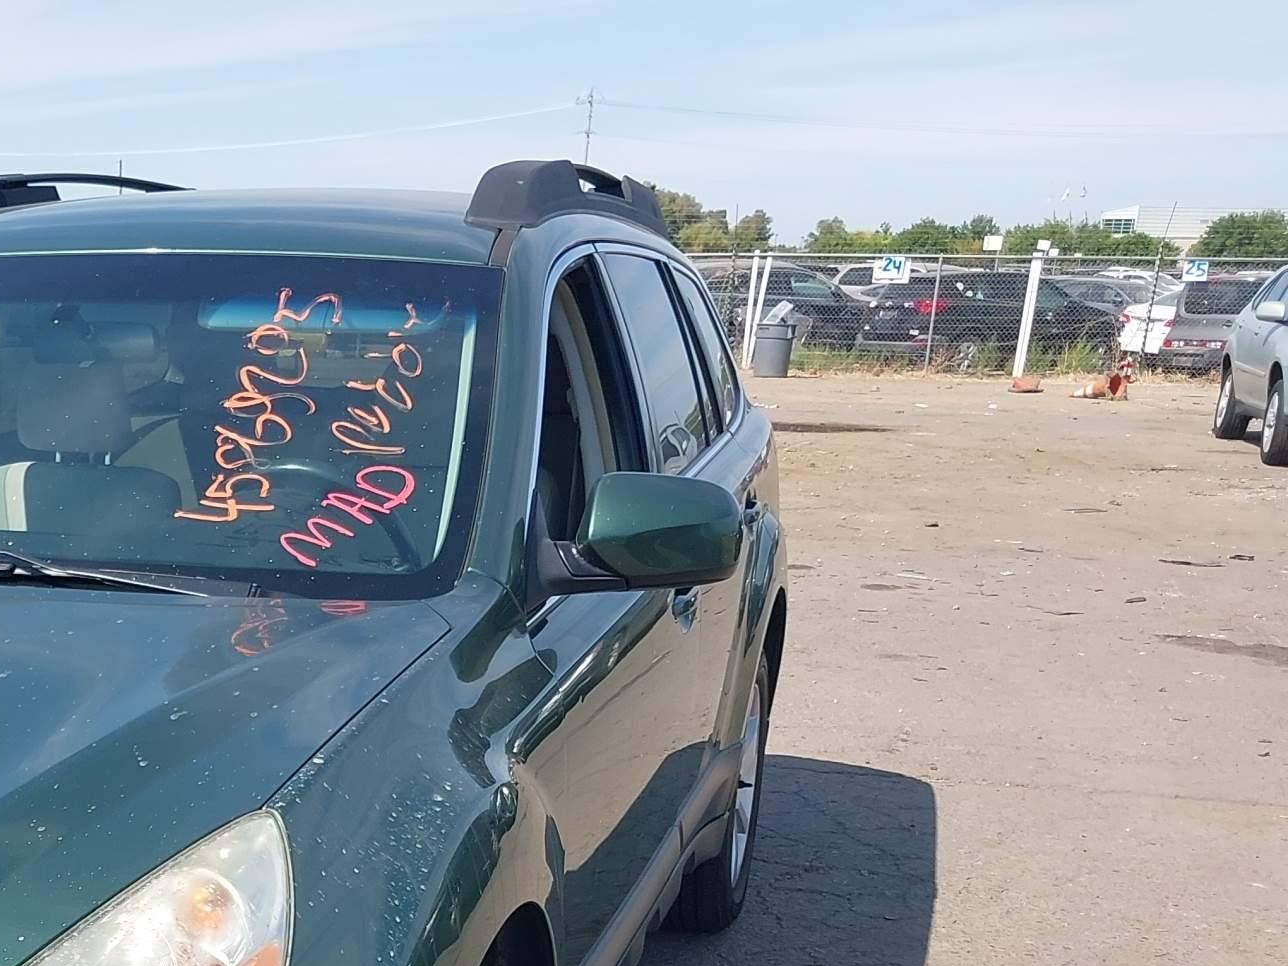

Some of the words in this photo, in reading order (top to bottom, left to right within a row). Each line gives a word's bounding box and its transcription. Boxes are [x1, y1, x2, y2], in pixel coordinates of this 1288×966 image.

[883, 257, 902, 274] 24
[1185, 261, 1207, 277] 25
[279, 465, 416, 567] MAD
